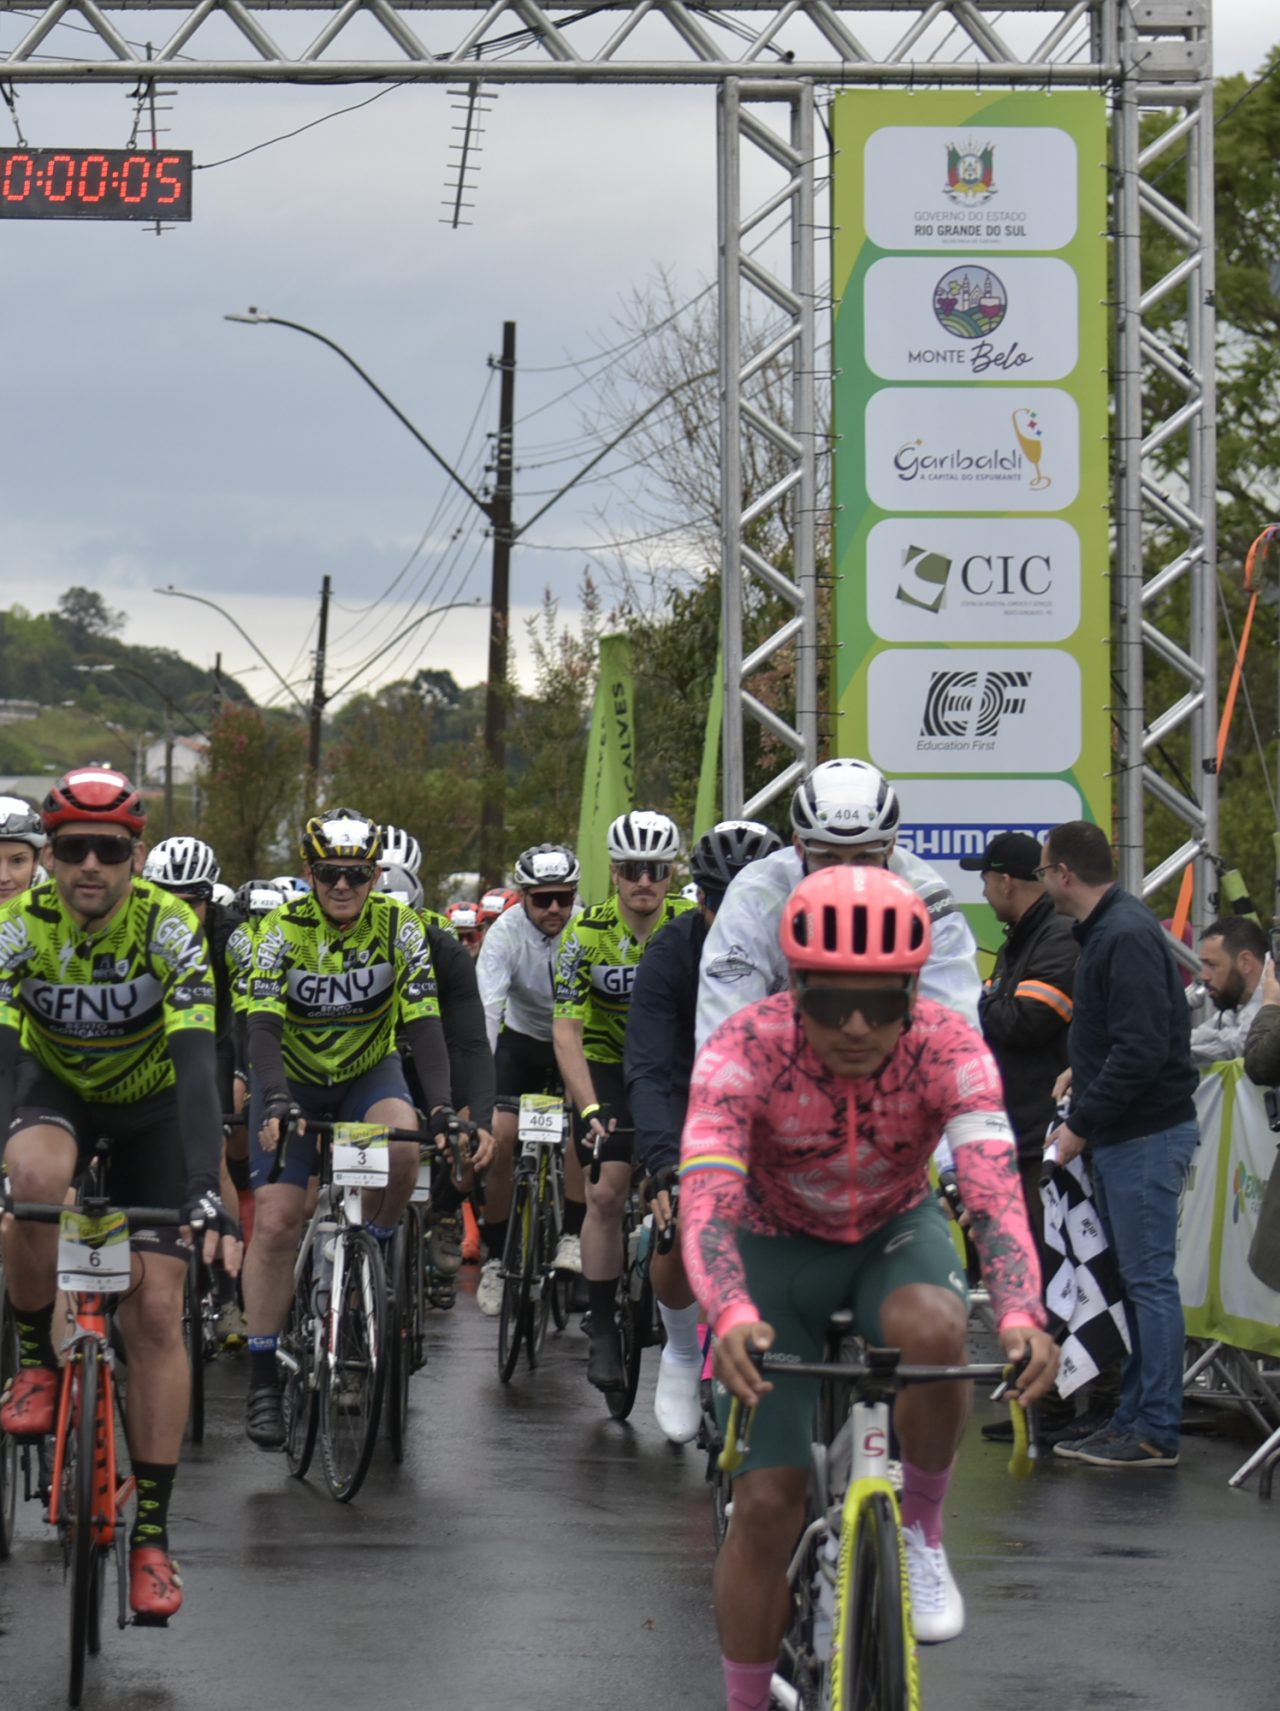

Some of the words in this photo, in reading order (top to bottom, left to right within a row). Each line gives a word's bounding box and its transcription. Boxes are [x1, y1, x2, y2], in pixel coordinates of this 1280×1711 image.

[914, 224, 934, 236] RIO
[937, 224, 982, 236] GRANDE
[985, 224, 1001, 236] DO
[1005, 224, 1027, 236] SUL
[908, 349, 956, 363] MONTE
[970, 340, 1034, 373] Belo
[893, 443, 1022, 481] Garibaldi
[961, 555, 1052, 595] CIC
[917, 740, 969, 751] Education
[972, 740, 996, 751] First
[834, 810, 861, 821] 404
[297, 969, 375, 1004] GFNY
[33, 983, 139, 1021] GFNY
[529, 1115, 553, 1127] 405
[357, 1151, 367, 1165] 3
[88, 1251, 100, 1267] 6
